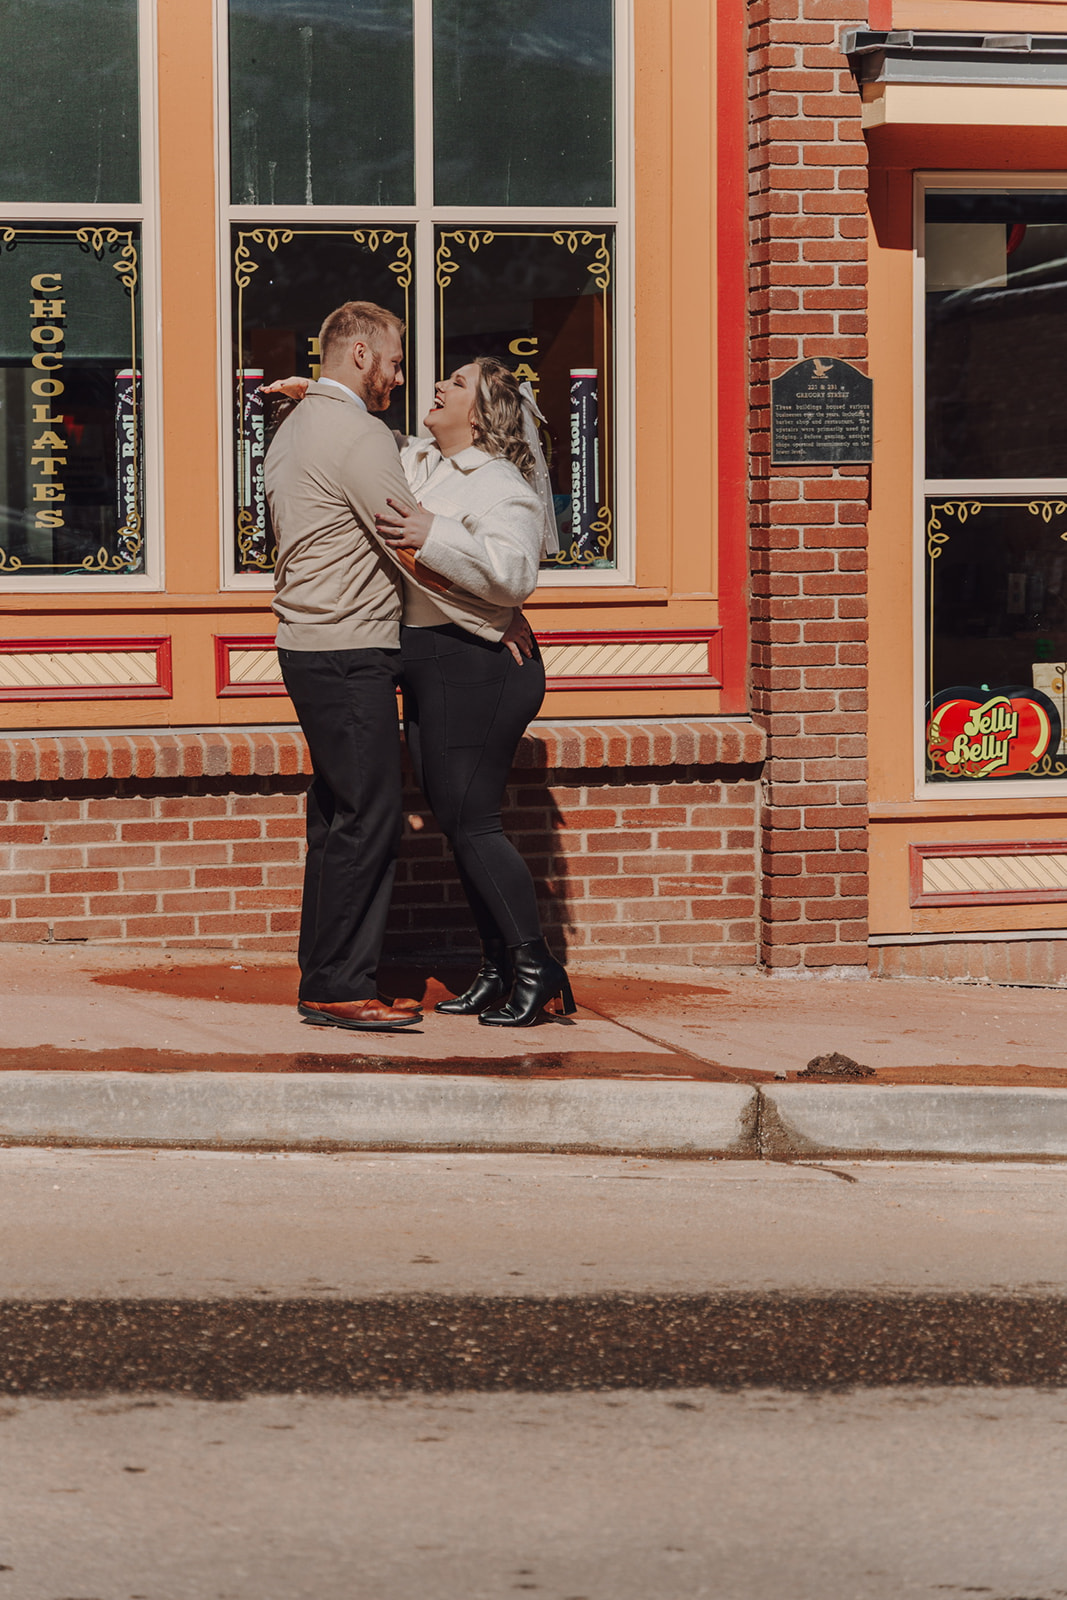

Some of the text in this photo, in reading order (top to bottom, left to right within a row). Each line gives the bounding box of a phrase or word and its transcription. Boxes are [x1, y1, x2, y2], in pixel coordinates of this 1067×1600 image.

[30, 274, 68, 528] CHOCOLATES
[251, 414, 266, 458] Roll
[964, 696, 1018, 738] Jelly
[946, 734, 1008, 778] Belly
